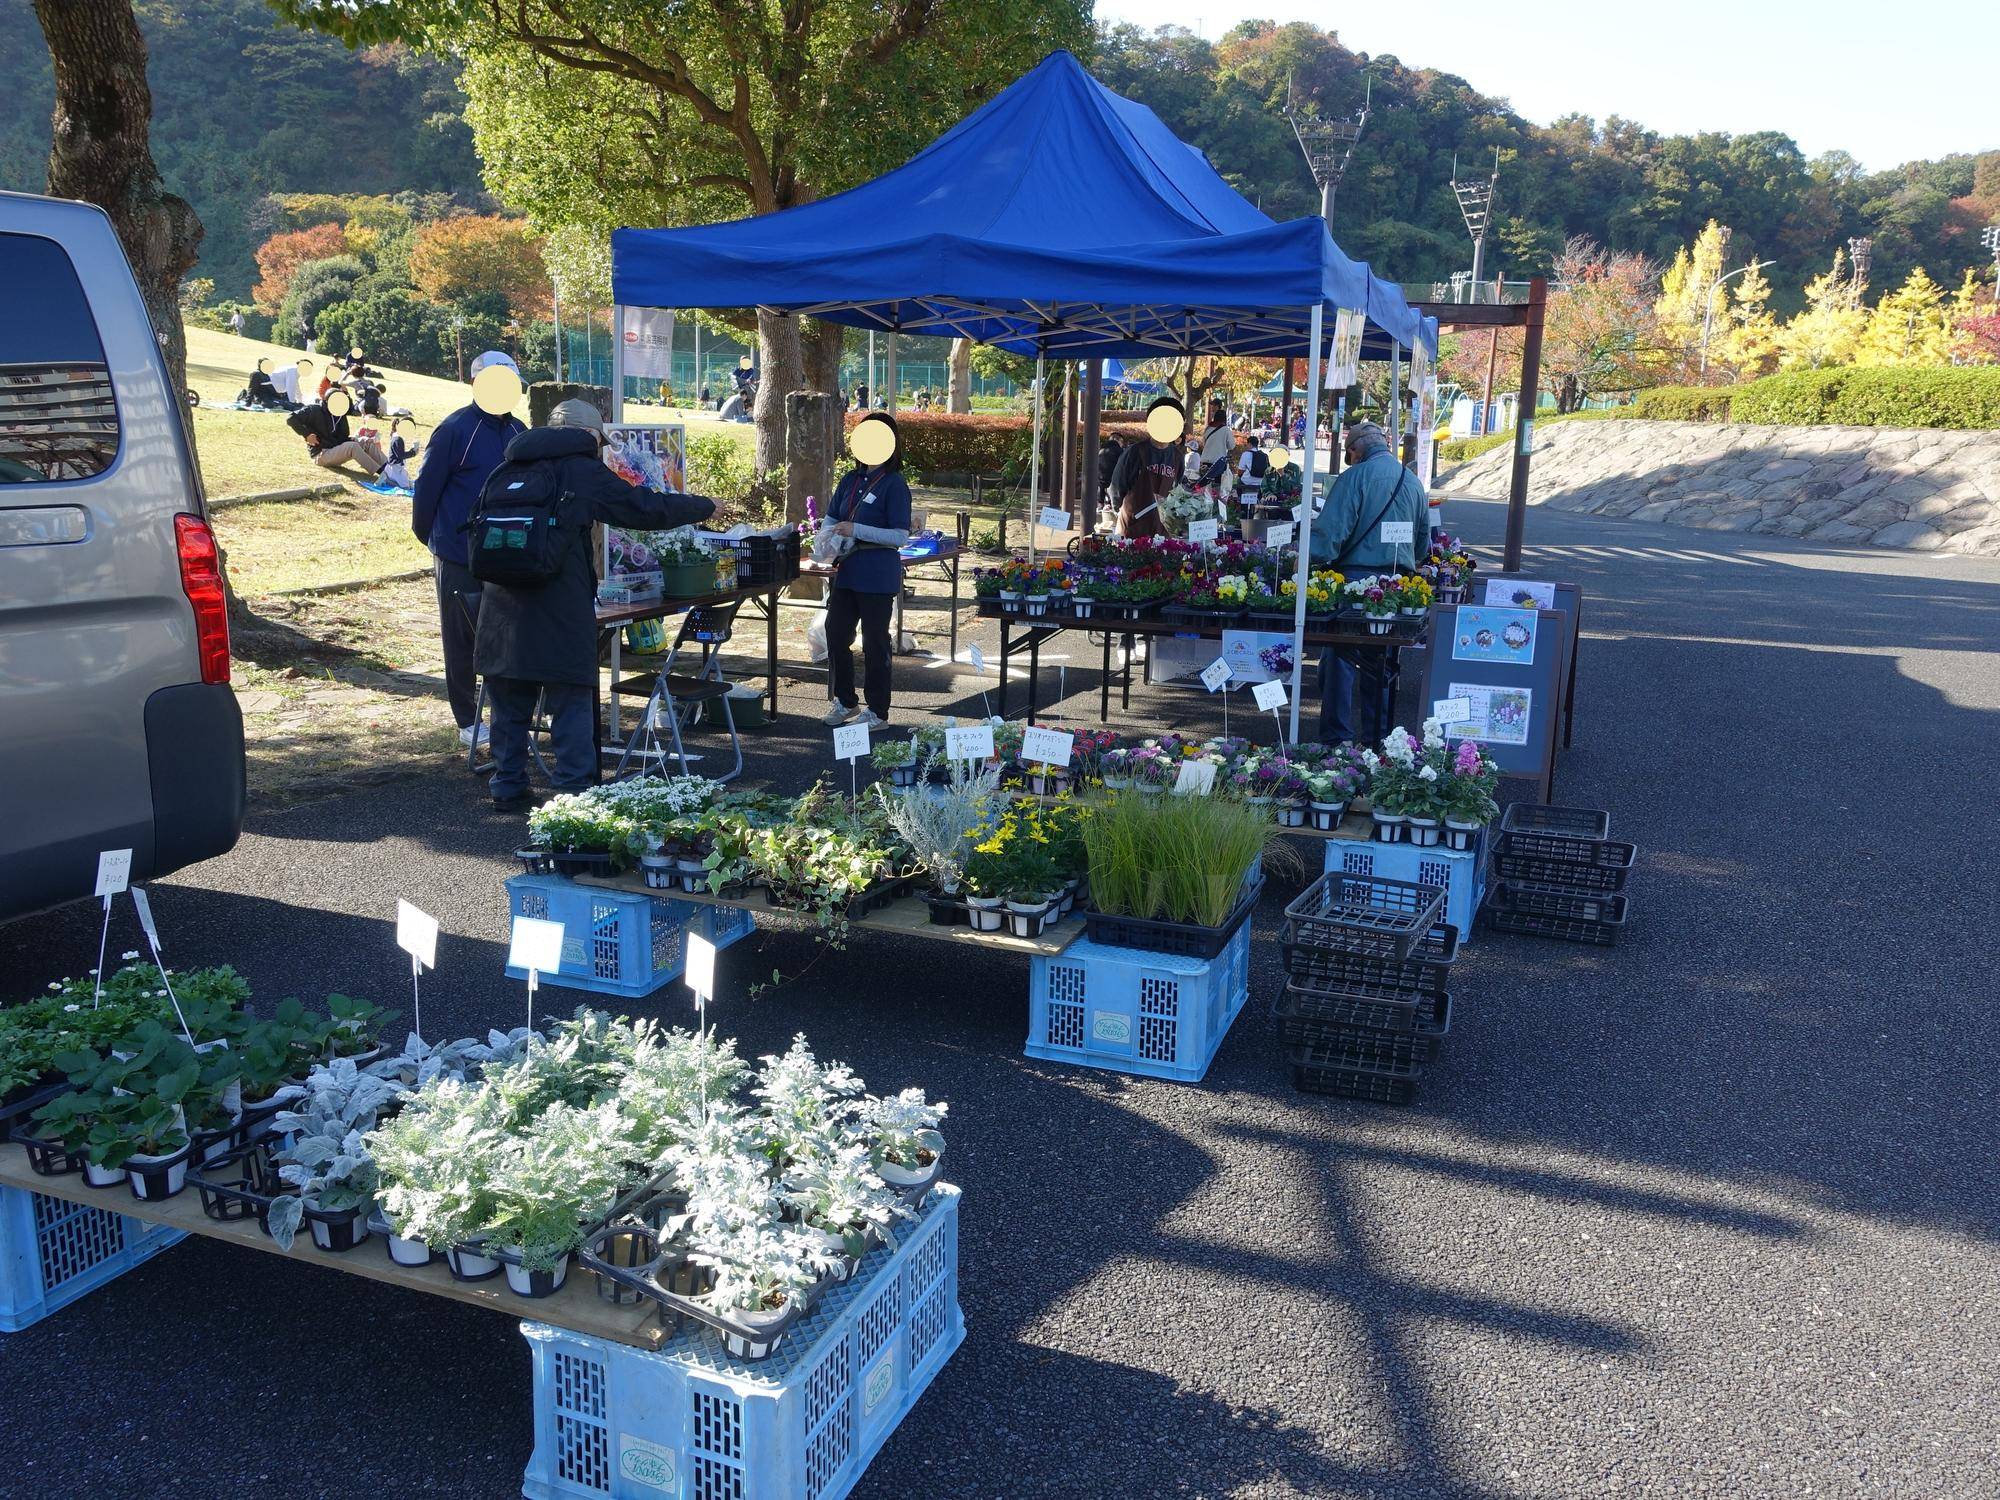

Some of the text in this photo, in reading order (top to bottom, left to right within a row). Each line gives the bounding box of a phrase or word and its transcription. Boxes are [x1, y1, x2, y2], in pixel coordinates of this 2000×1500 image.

[608, 429, 682, 455] GREEN
[837, 727, 857, 739] ヘデラ
